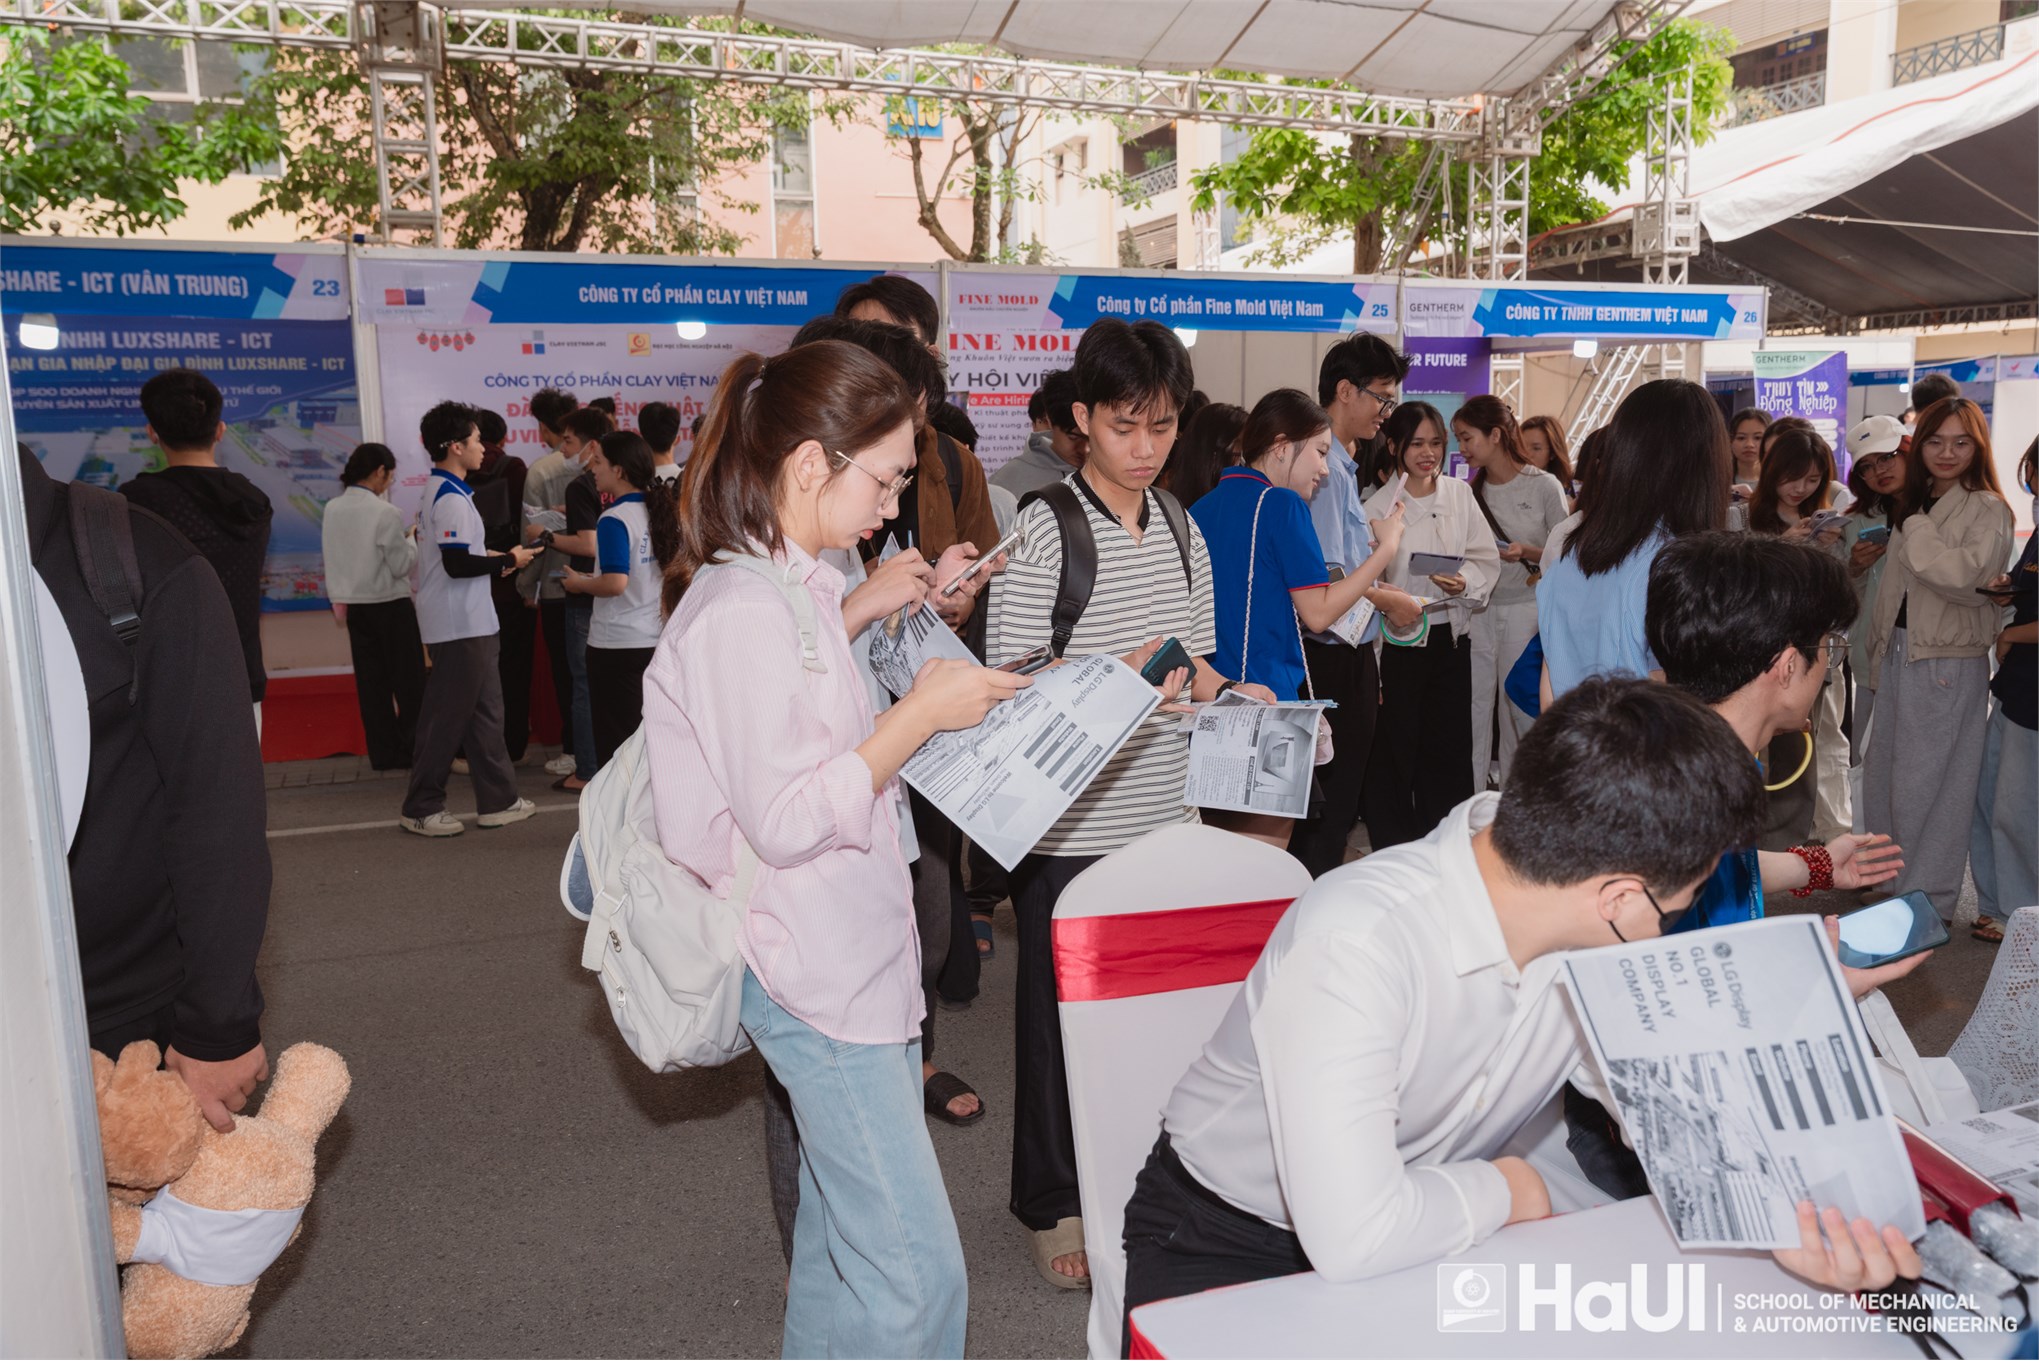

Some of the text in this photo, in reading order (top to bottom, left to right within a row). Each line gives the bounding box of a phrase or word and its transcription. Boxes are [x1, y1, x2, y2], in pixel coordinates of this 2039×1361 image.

[82, 271, 114, 293] ICT
[121, 269, 170, 296] (VÂN
[174, 274, 249, 299] TRUNG)
[312, 279, 340, 296] 23
[579, 284, 618, 304] CÔNG
[622, 287, 638, 303] TY
[642, 283, 662, 304] CỔ
[706, 289, 741, 305] CLAY
[745, 287, 774, 308] VIỆT
[777, 290, 808, 306] NAM
[959, 294, 1039, 305] FINE MOLD
[1097, 294, 1323, 320] Công ty Cổ phần Fine Mold Việt Nam
[1372, 304, 1388, 317] 25
[1410, 303, 1464, 313] GENTHERM
[1506, 303, 1708, 325] CÔNG TY TNHH GENTHEM VIỆT NAM
[1744, 311, 1757, 323] 26
[61, 331, 106, 348] NHH
[112, 331, 221, 349] LUXSHARE
[241, 333, 272, 349] ICT
[949, 333, 1077, 352] INE MOL
[10, 357, 34, 373] ẠN
[38, 356, 67, 371] GIA
[71, 354, 117, 373] NHẬP
[121, 356, 149, 373] ĐẠI
[154, 356, 181, 370] GIA
[185, 354, 223, 370] ĐÌNH
[228, 357, 307, 371] LUXSHARE
[322, 357, 346, 371] ICT
[965, 352, 995, 361] Khuôn
[998, 353, 1016, 363] Việt
[1425, 353, 1468, 367] FUTURE
[1756, 355, 1806, 364] GENTHERM
[485, 370, 719, 390] CÔNG TY CỔ PHẦN CLAY VIỆT NA
[968, 368, 1008, 391] HỘI
[1764, 381, 1793, 397] TRUY
[60, 386, 108, 396] DOANH
[981, 396, 1002, 405] Are
[1005, 396, 1029, 405] Hirin
[507, 397, 533, 417] ĐÀ
[1798, 394, 1838, 416] Nghiệp
[1072, 657, 1103, 685] GLOBAL
[1071, 672, 1106, 708] LG Display
[992, 771, 1012, 793] Welcome
[981, 797, 990, 806] LG
[966, 804, 983, 821] Display
[1641, 954, 1677, 1018] DISPLAY
[1690, 946, 1721, 1008] GLOBAL
[1618, 958, 1658, 1033] COMPANY
[1720, 961, 1752, 1030] LG Display
